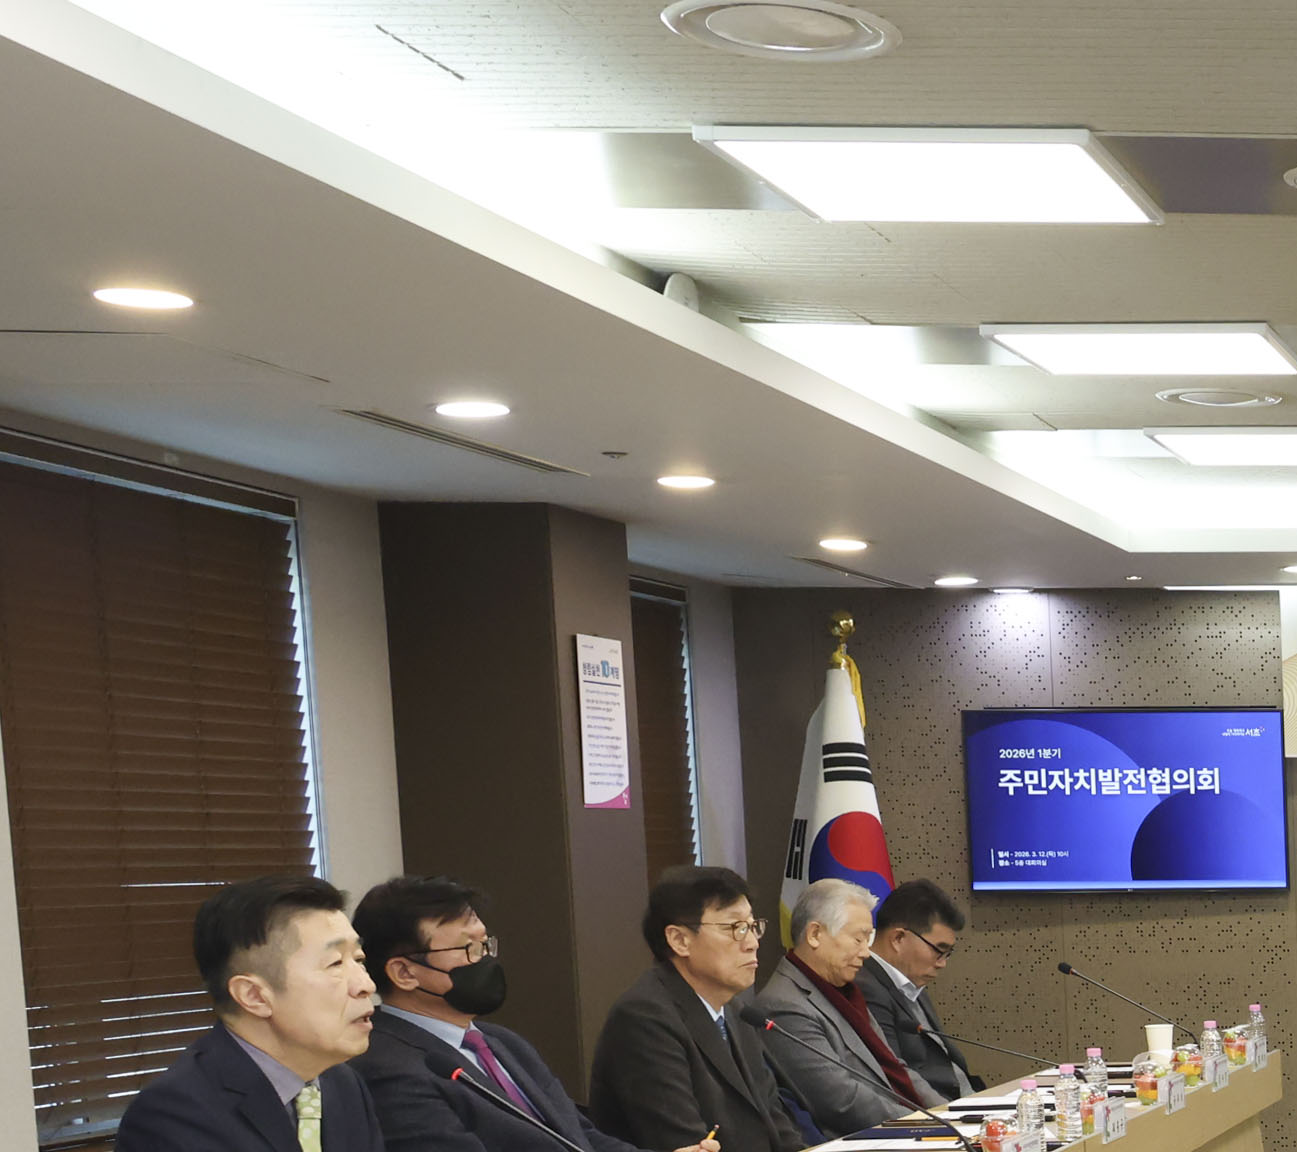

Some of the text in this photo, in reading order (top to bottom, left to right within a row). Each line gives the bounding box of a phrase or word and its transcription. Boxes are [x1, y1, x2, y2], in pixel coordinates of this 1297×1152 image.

[999, 747, 1062, 760] 2026년 1분기
[998, 766, 1220, 796] 주민자치발전협의회
